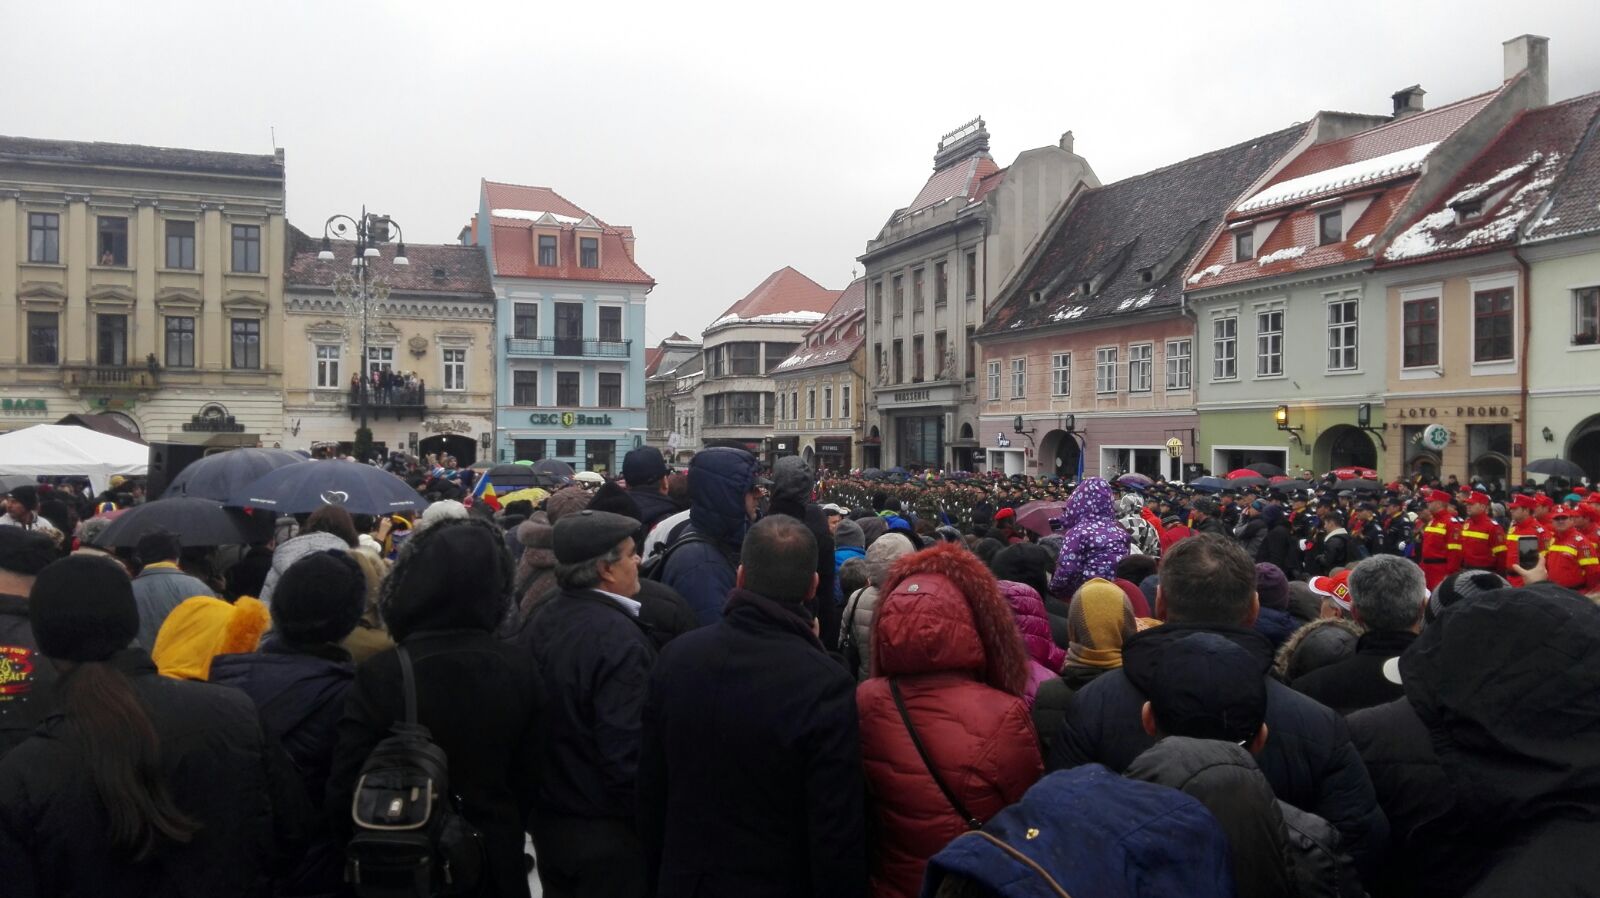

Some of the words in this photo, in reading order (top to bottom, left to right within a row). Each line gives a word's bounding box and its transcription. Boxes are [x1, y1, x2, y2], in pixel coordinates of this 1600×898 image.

[1399, 407, 1437, 418] LOTO
[1457, 406, 1509, 417] PROMO
[529, 413, 558, 425] CEC
[577, 413, 613, 426] Bank
